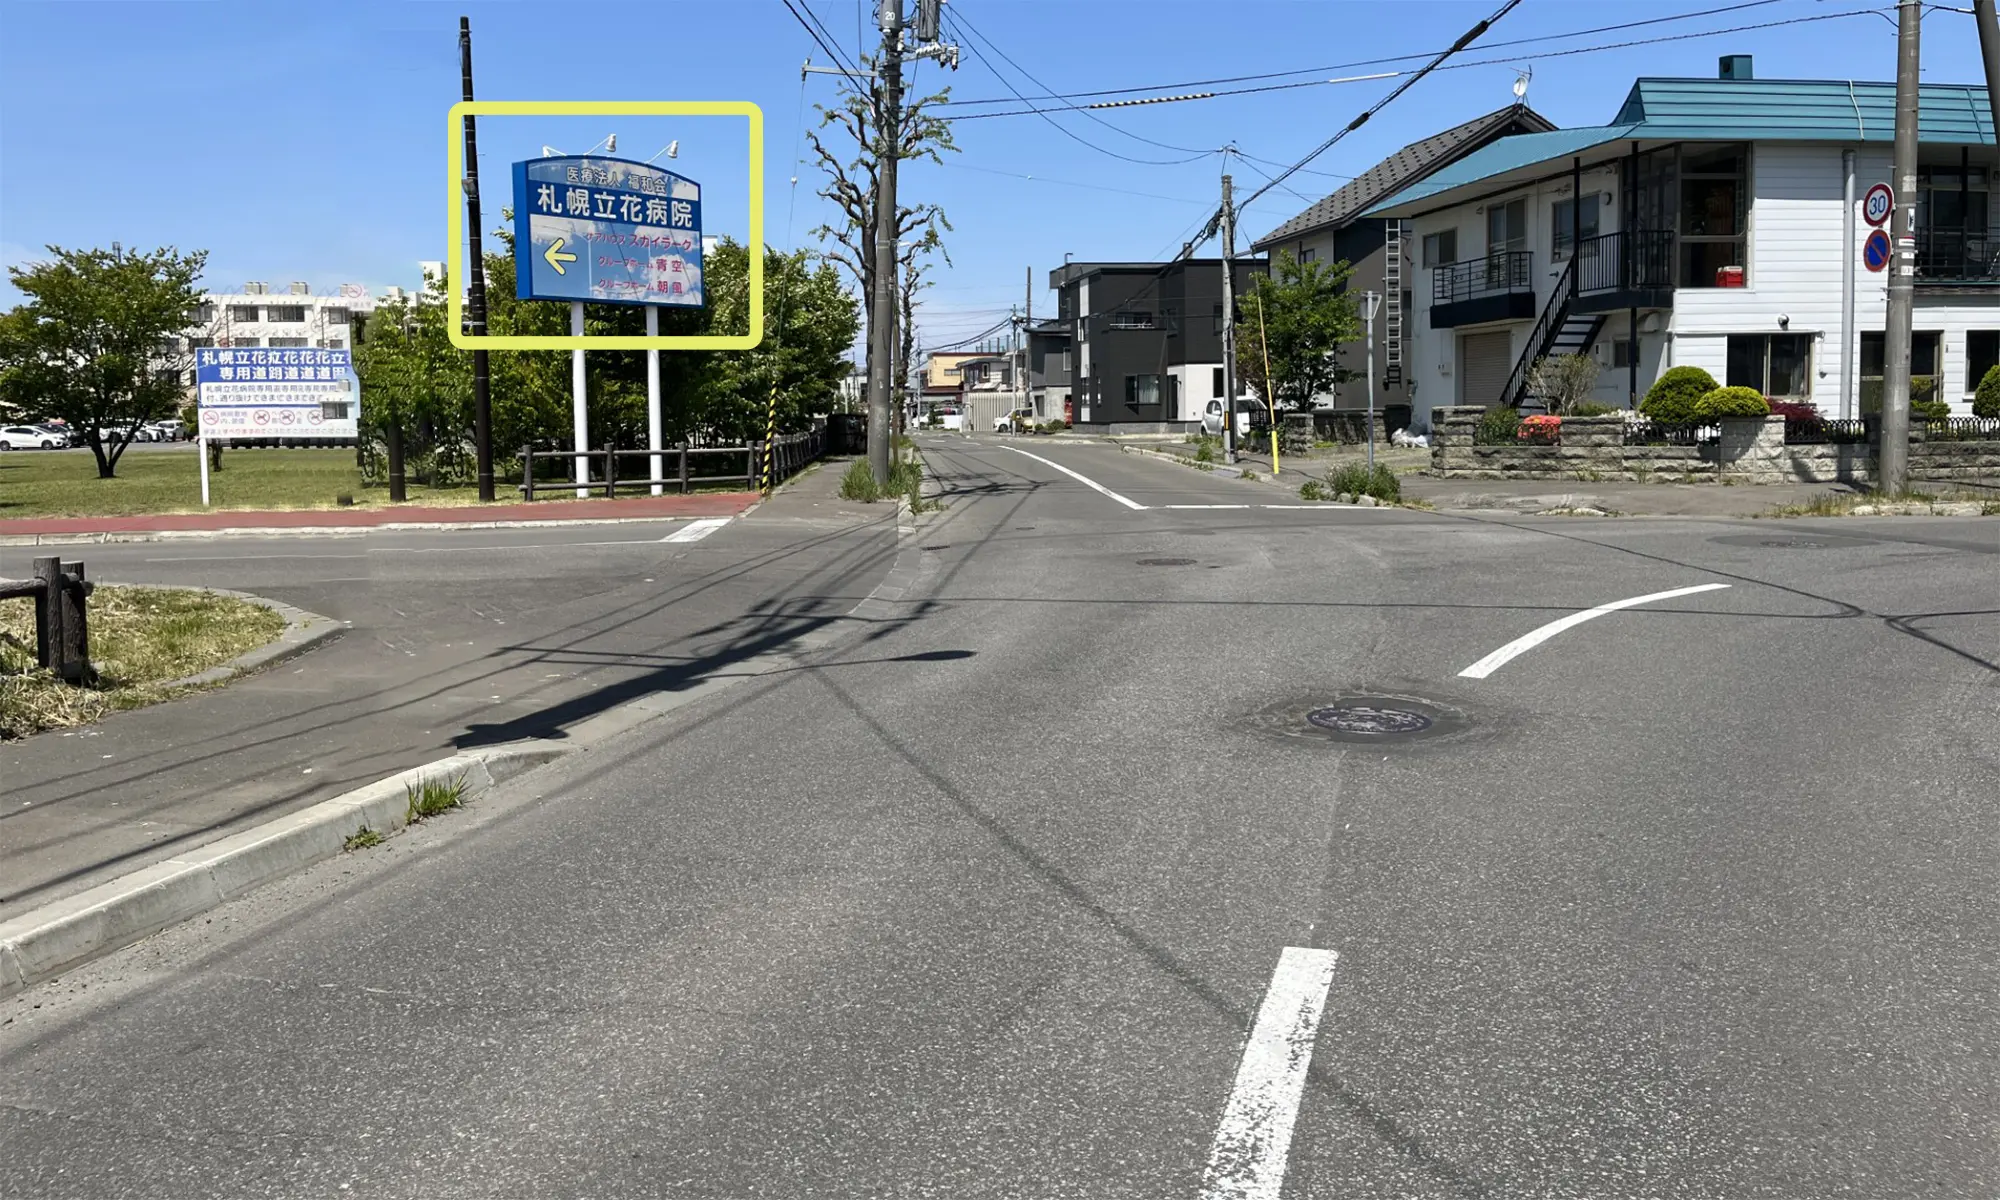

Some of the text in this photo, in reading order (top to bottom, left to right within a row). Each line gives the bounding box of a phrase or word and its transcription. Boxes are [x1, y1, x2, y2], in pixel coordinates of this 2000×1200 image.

[885, 11, 896, 20] 20
[566, 166, 621, 188] 医療法人
[537, 183, 693, 228] 札幌立花病院
[1869, 195, 1886, 215] 30
[628, 233, 692, 251] スカイラーク
[656, 258, 683, 273] 青空
